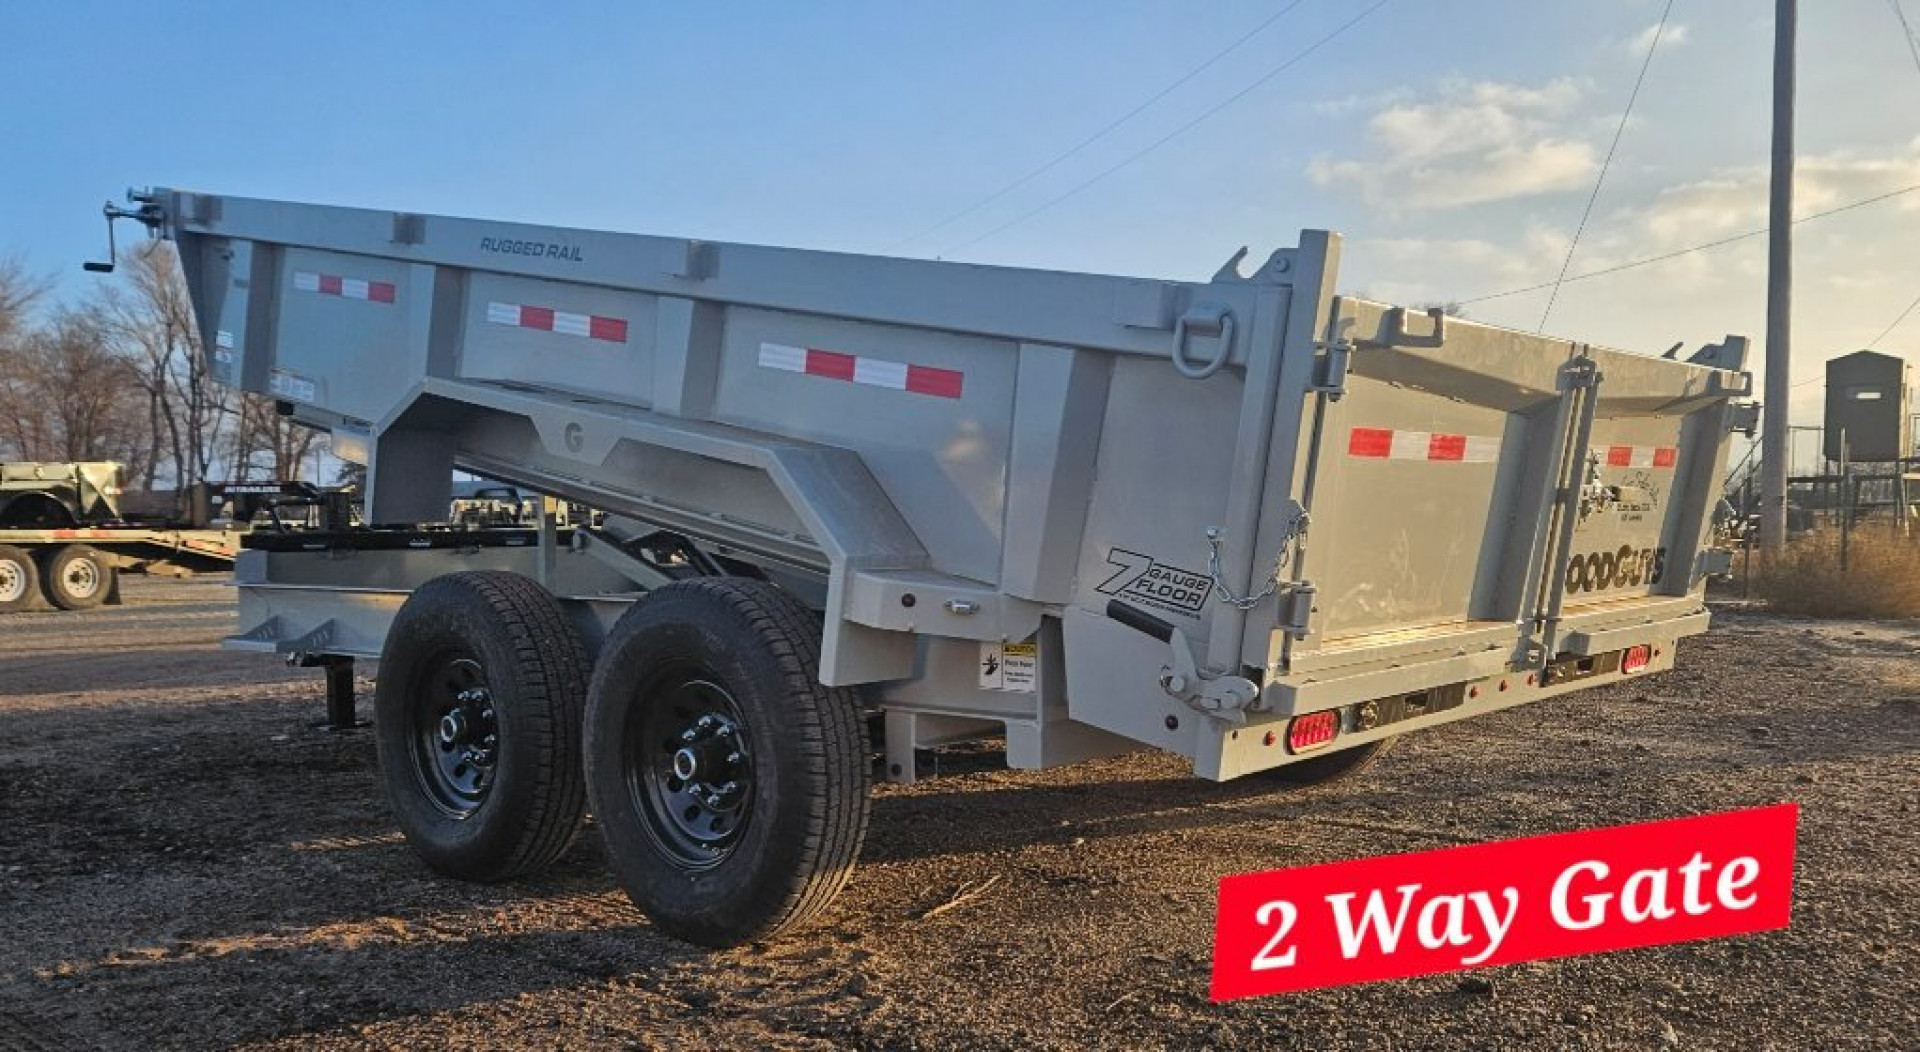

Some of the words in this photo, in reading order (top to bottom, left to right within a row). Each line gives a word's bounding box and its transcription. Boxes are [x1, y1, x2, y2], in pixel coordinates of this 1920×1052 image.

[481, 238, 545, 256] RUGGED
[547, 243, 583, 262] RAIL
[565, 422, 584, 453] G
[1095, 547, 1154, 596] 7
[1149, 568, 1208, 590] GAUGE
[1564, 544, 1667, 594] OODGUYS
[1136, 578, 1202, 605] FLOOR
